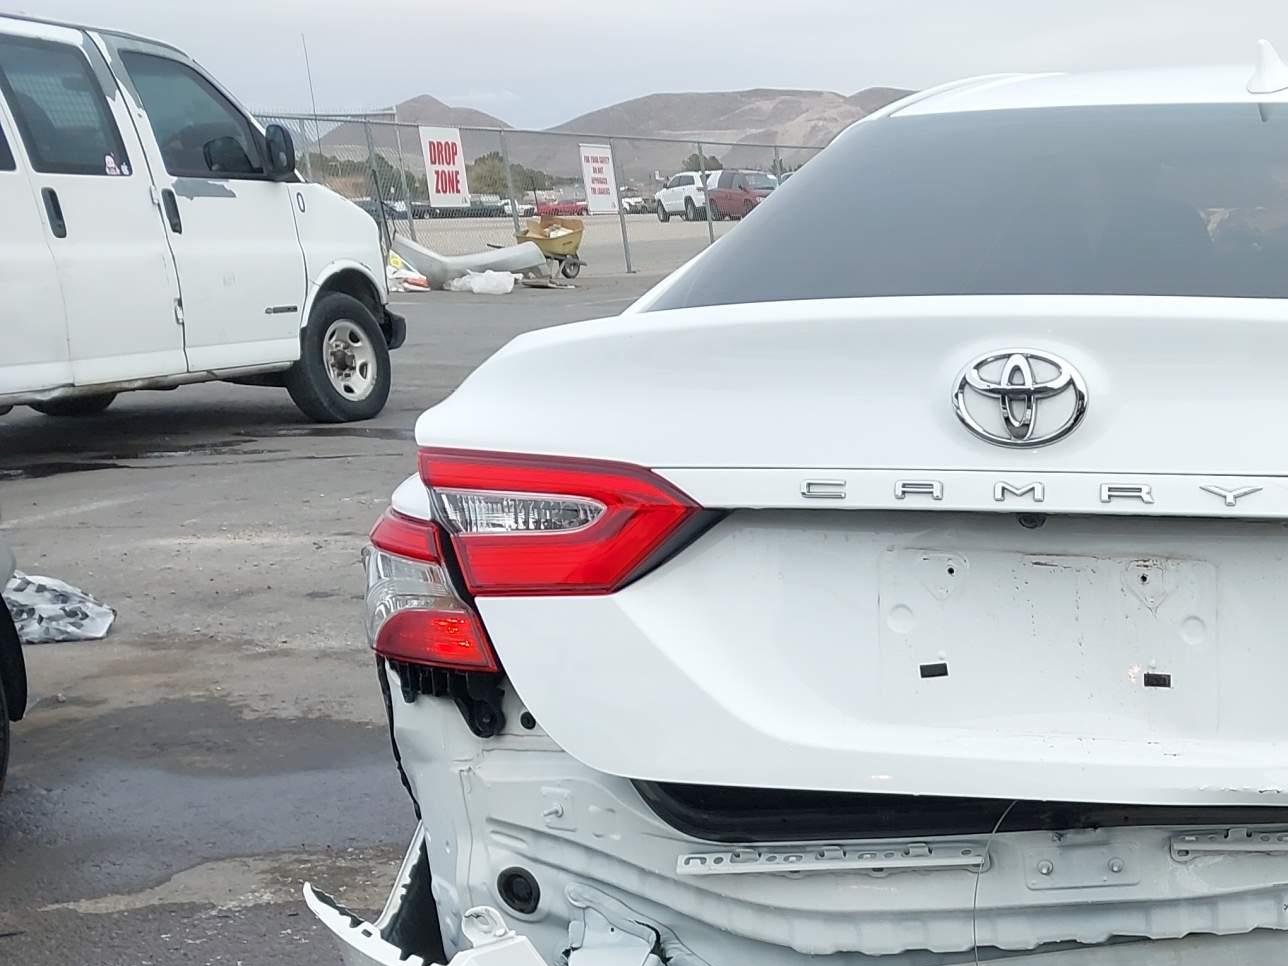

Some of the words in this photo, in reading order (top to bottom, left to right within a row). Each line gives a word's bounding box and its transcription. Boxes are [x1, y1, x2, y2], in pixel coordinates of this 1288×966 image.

[428, 141, 458, 166] DROP
[434, 169, 461, 194] ZONE
[800, 479, 1264, 507] CAMRY
